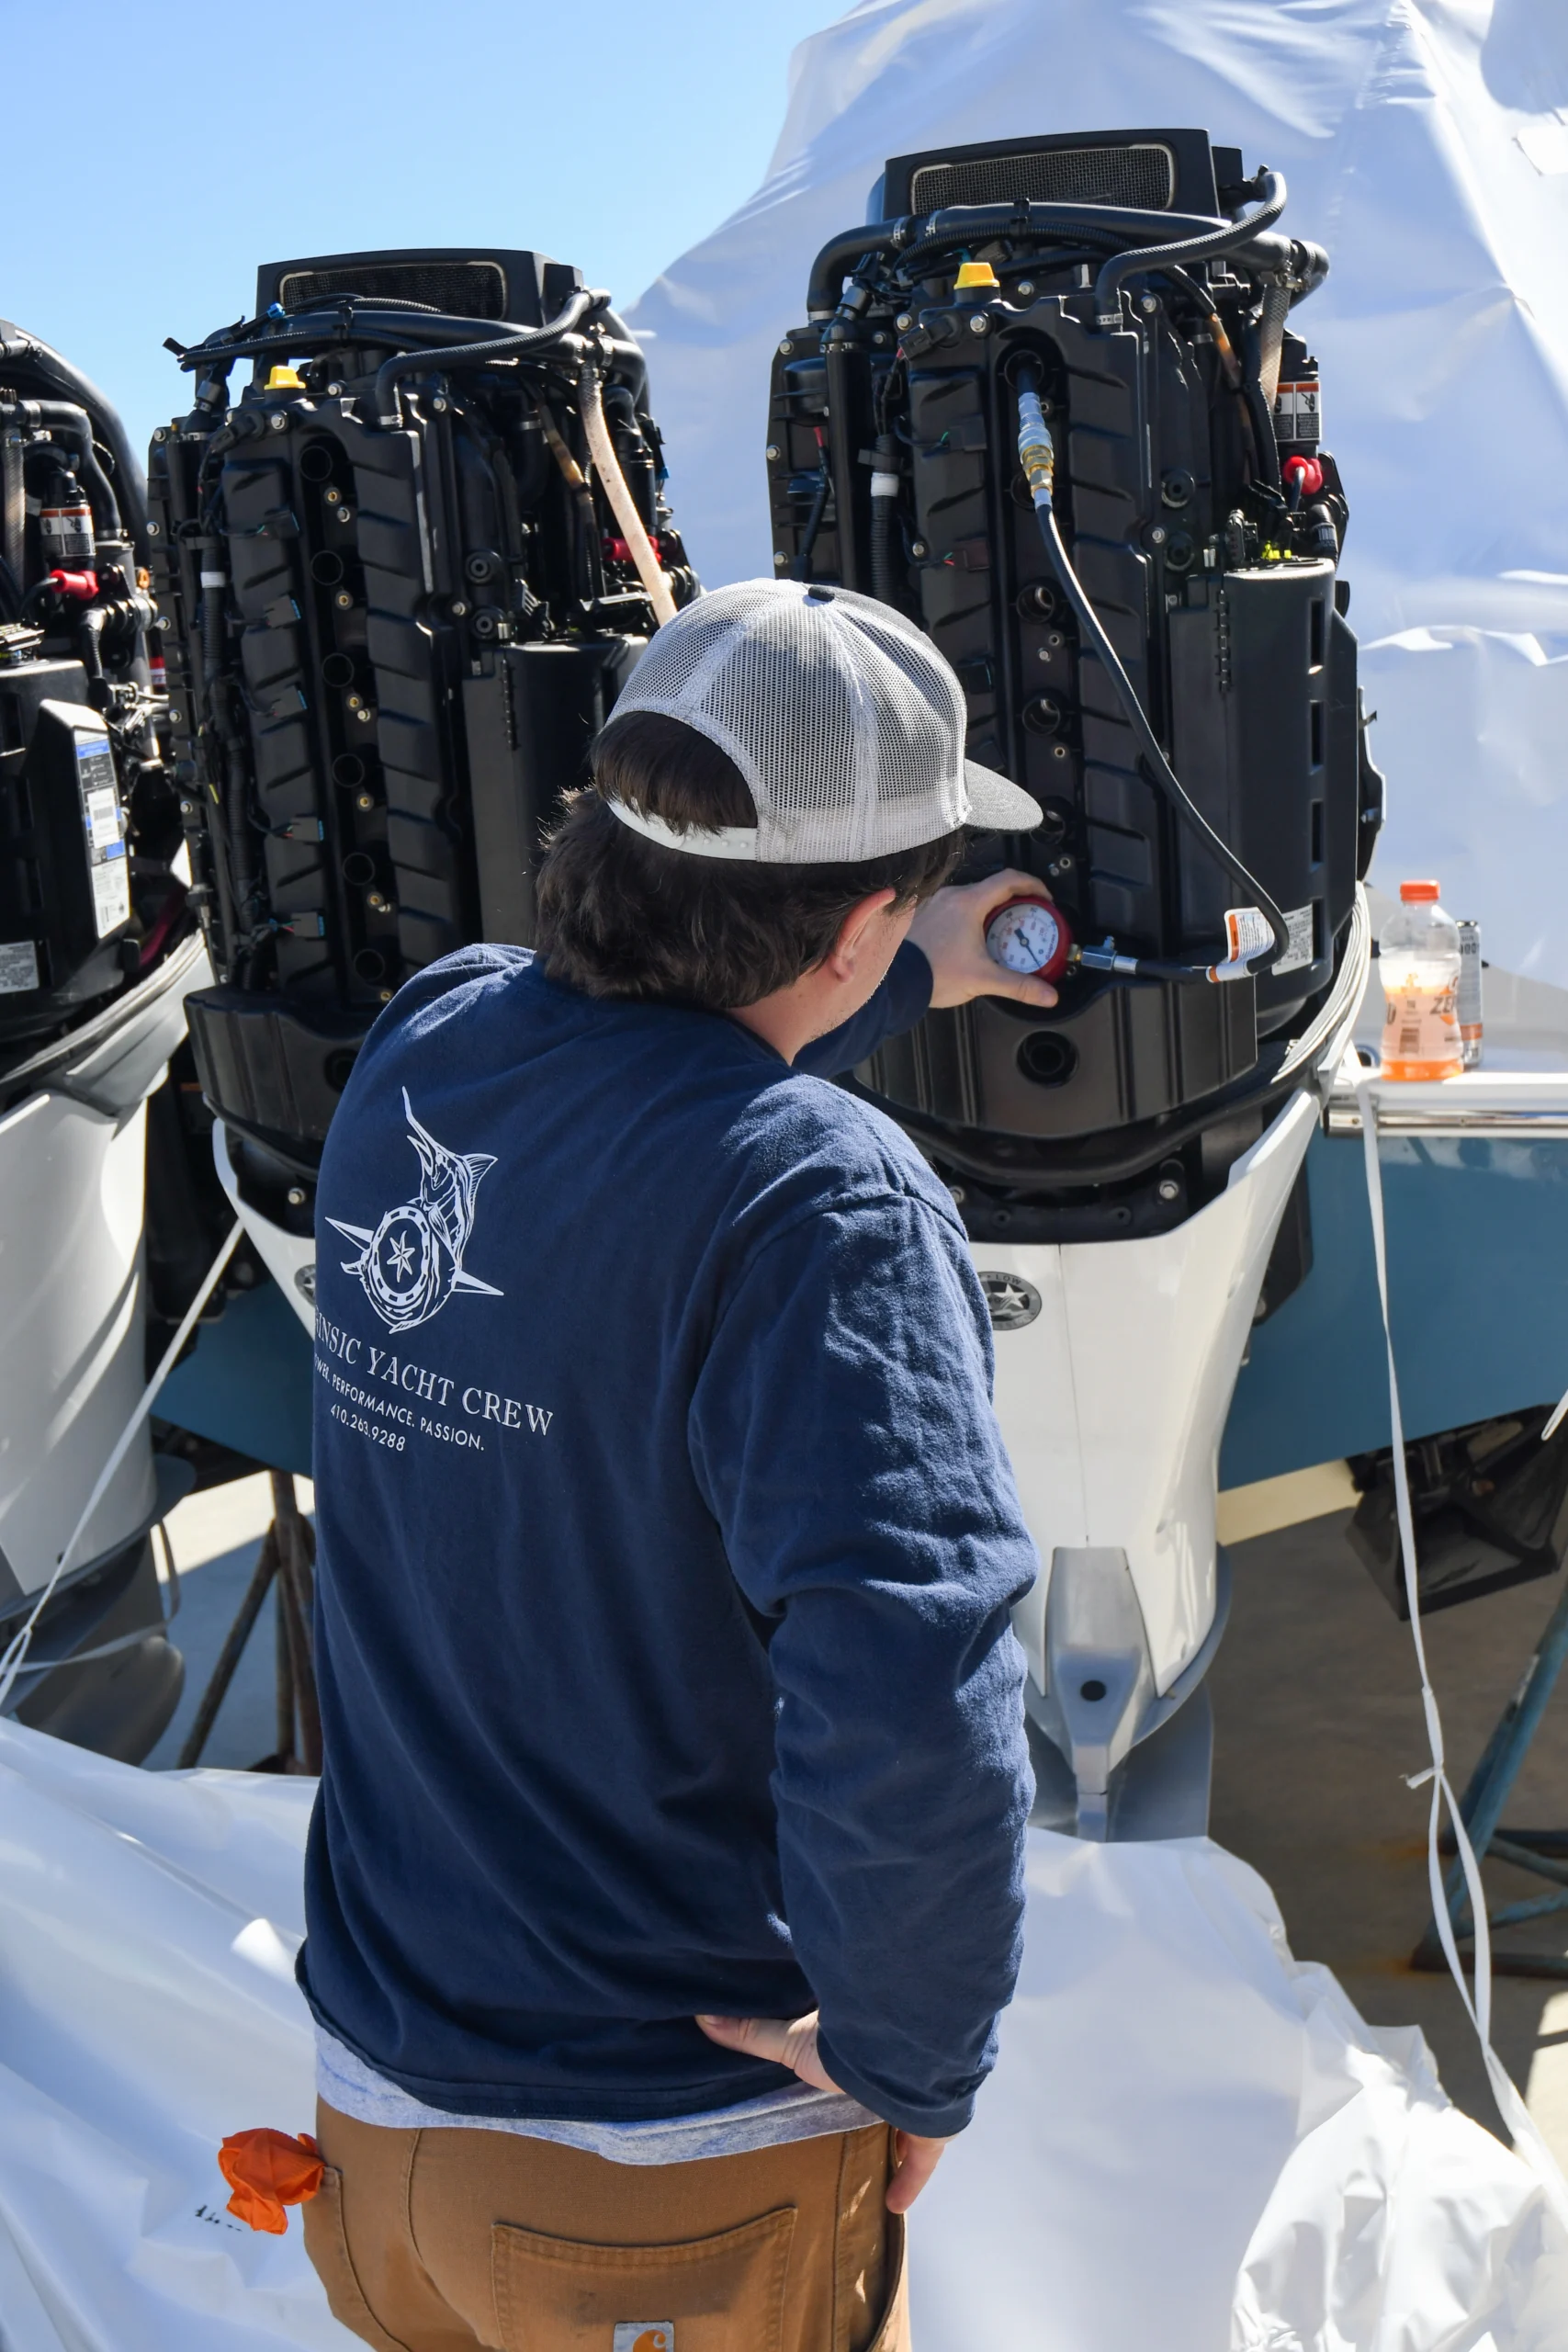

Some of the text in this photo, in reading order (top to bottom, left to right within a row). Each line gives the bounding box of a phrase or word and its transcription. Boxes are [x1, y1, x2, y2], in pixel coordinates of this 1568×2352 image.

[996, 1273, 1021, 1284] LOW
[333, 1374, 415, 1428] PERFORMANCE.
[420, 1417, 485, 1452] PASSION.
[367, 1346, 455, 1407] YACHT
[462, 1387, 554, 1436] CREW
[331, 1403, 406, 1452] 410.263.9288
